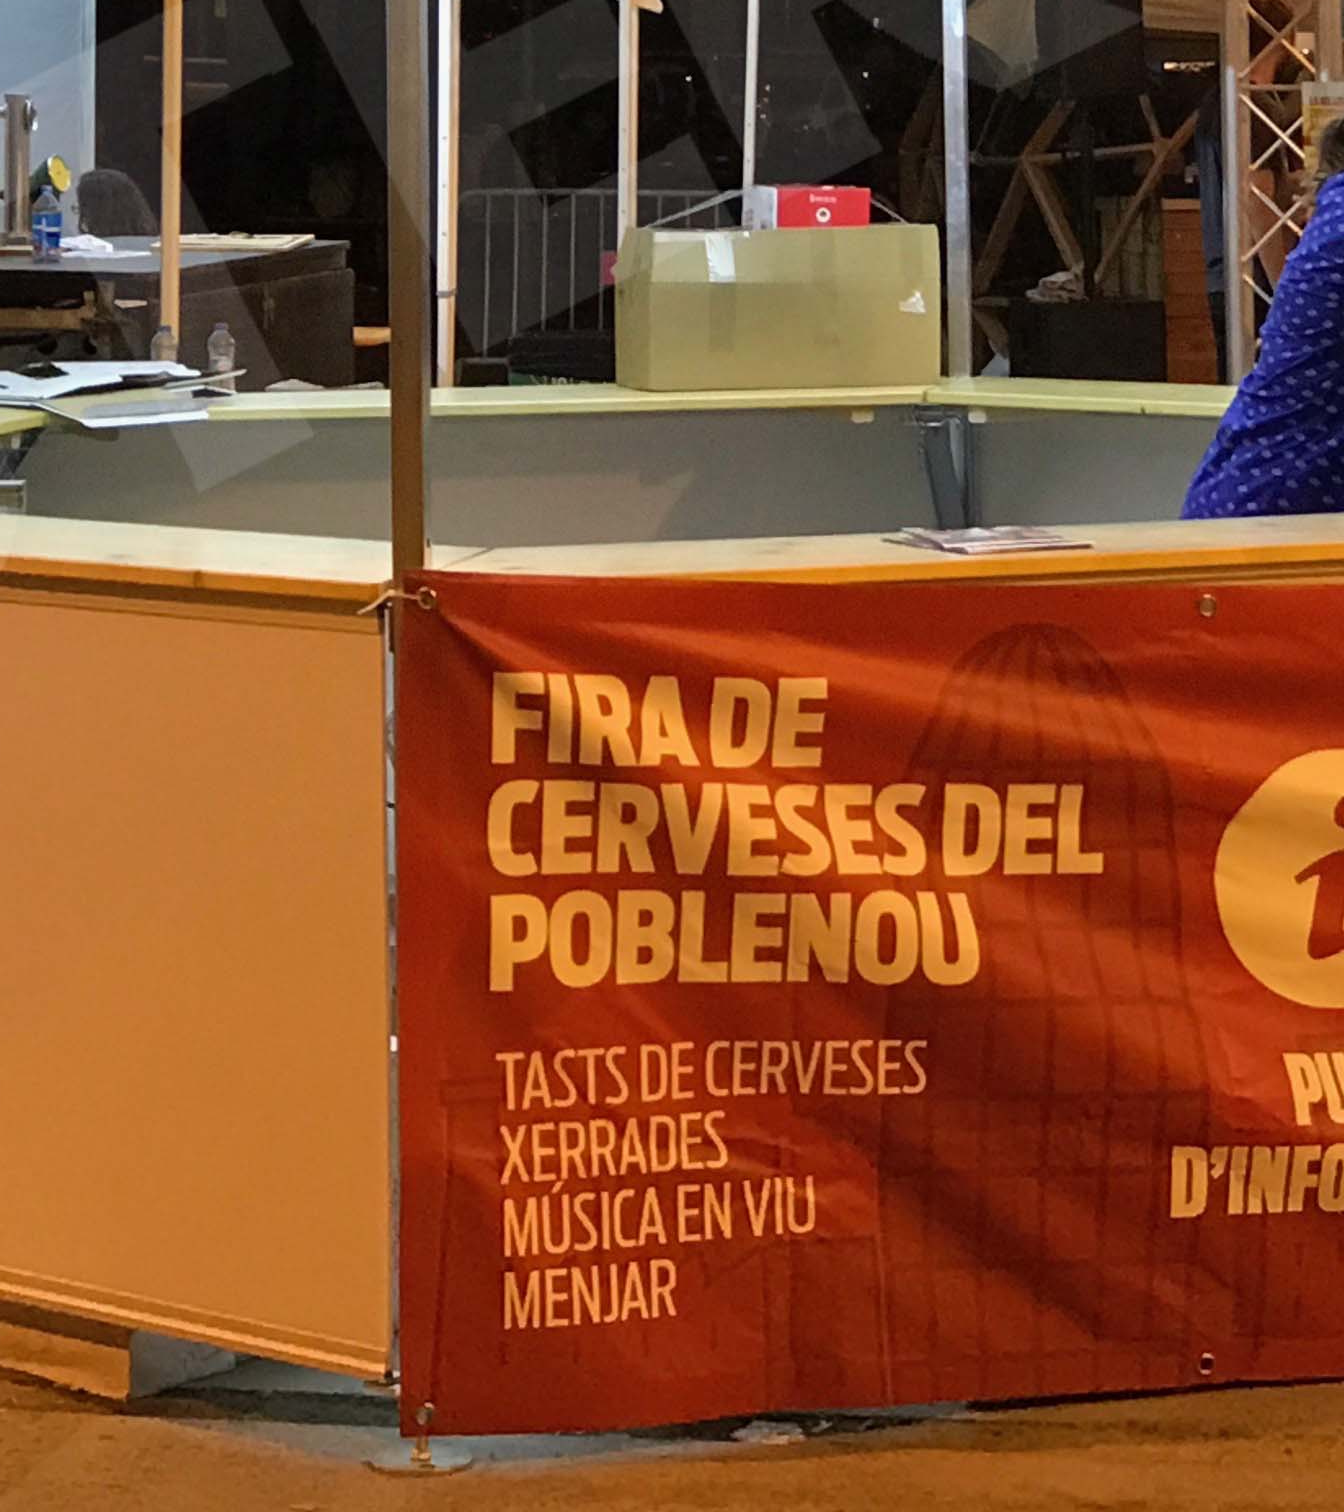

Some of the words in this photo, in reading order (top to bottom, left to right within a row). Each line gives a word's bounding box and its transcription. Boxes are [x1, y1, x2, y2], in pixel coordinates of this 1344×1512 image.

[491, 672, 698, 767] FIRA
[709, 678, 828, 768] DE
[487, 780, 927, 877] CERVESES
[942, 784, 1104, 877] DEL
[489, 889, 981, 992] POBLENOU
[496, 1046, 629, 1110] TASTS
[640, 1042, 695, 1102] DE
[705, 1040, 927, 1097] CERVESES
[500, 1111, 728, 1184] XERRADES
[504, 1181, 666, 1257] MÚSICA
[676, 1182, 732, 1242] EN
[744, 1176, 816, 1237] VIU
[503, 1259, 677, 1330] MENJAR
